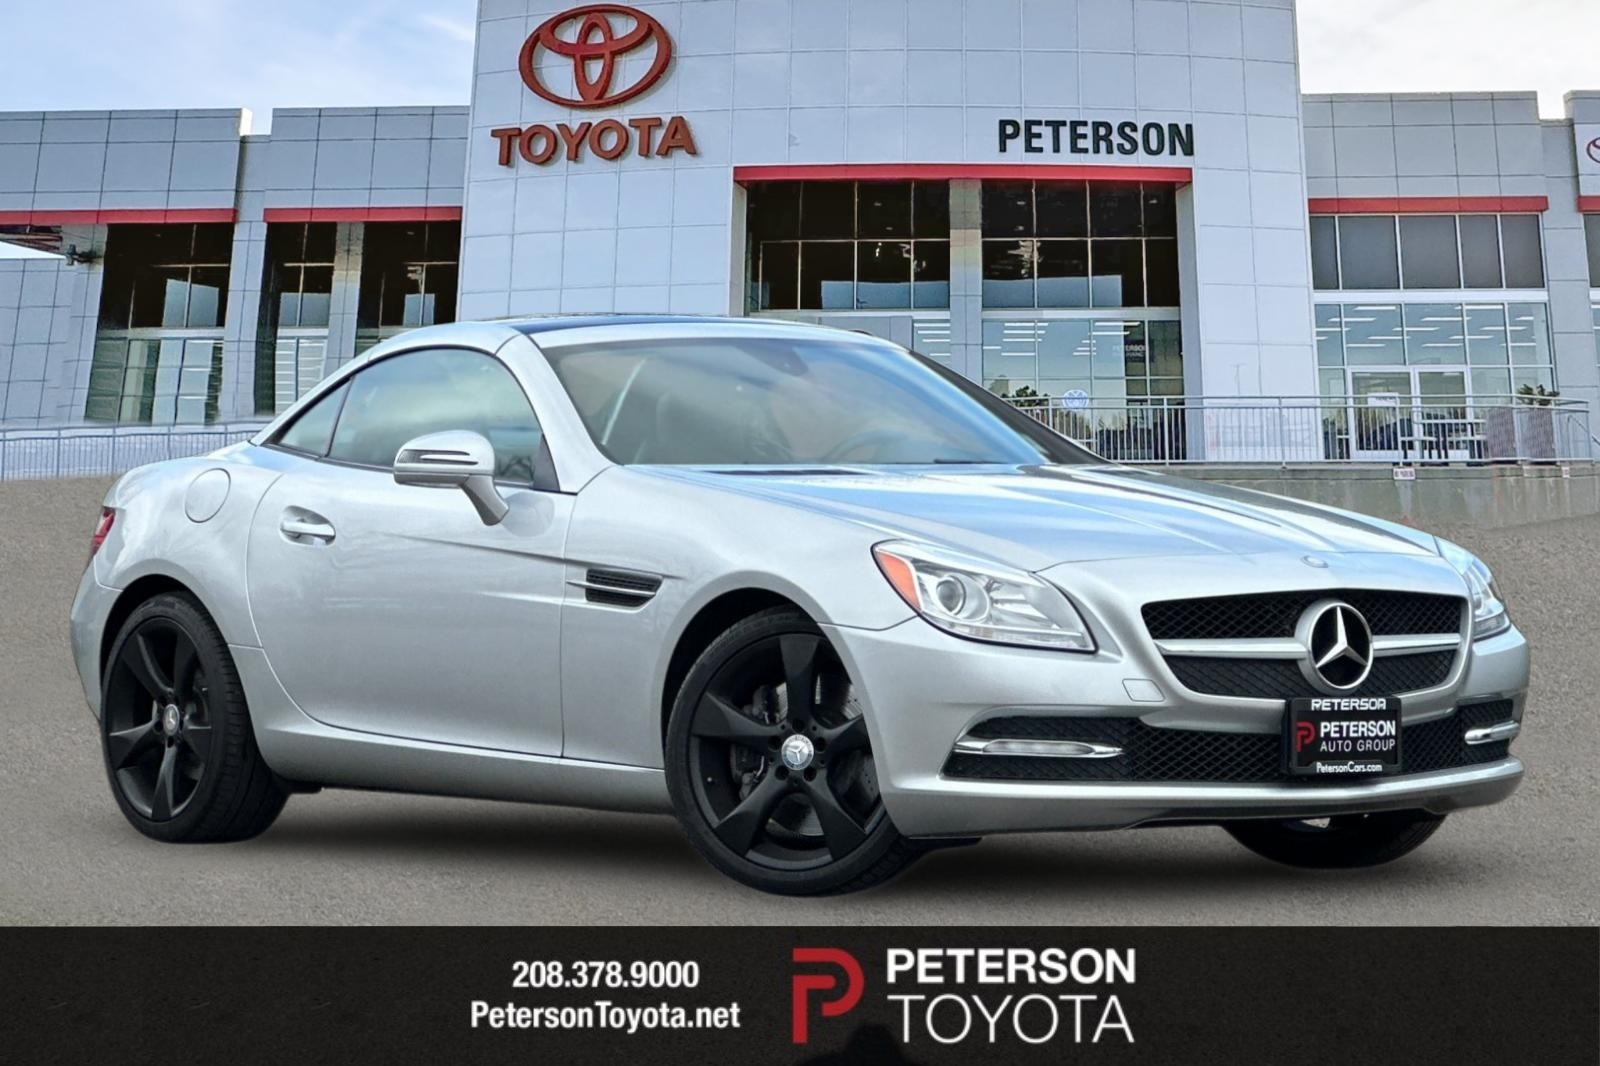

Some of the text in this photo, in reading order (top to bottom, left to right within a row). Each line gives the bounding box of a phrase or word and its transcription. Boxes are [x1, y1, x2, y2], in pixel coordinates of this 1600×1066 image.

[491, 115, 697, 166] TOYOTA
[998, 119, 1195, 156] PETERSON
[1320, 720, 1396, 738] PETERSON
[1320, 738, 1396, 752] AUTO GROUP
[1316, 761, 1383, 773] PetersonCars.com
